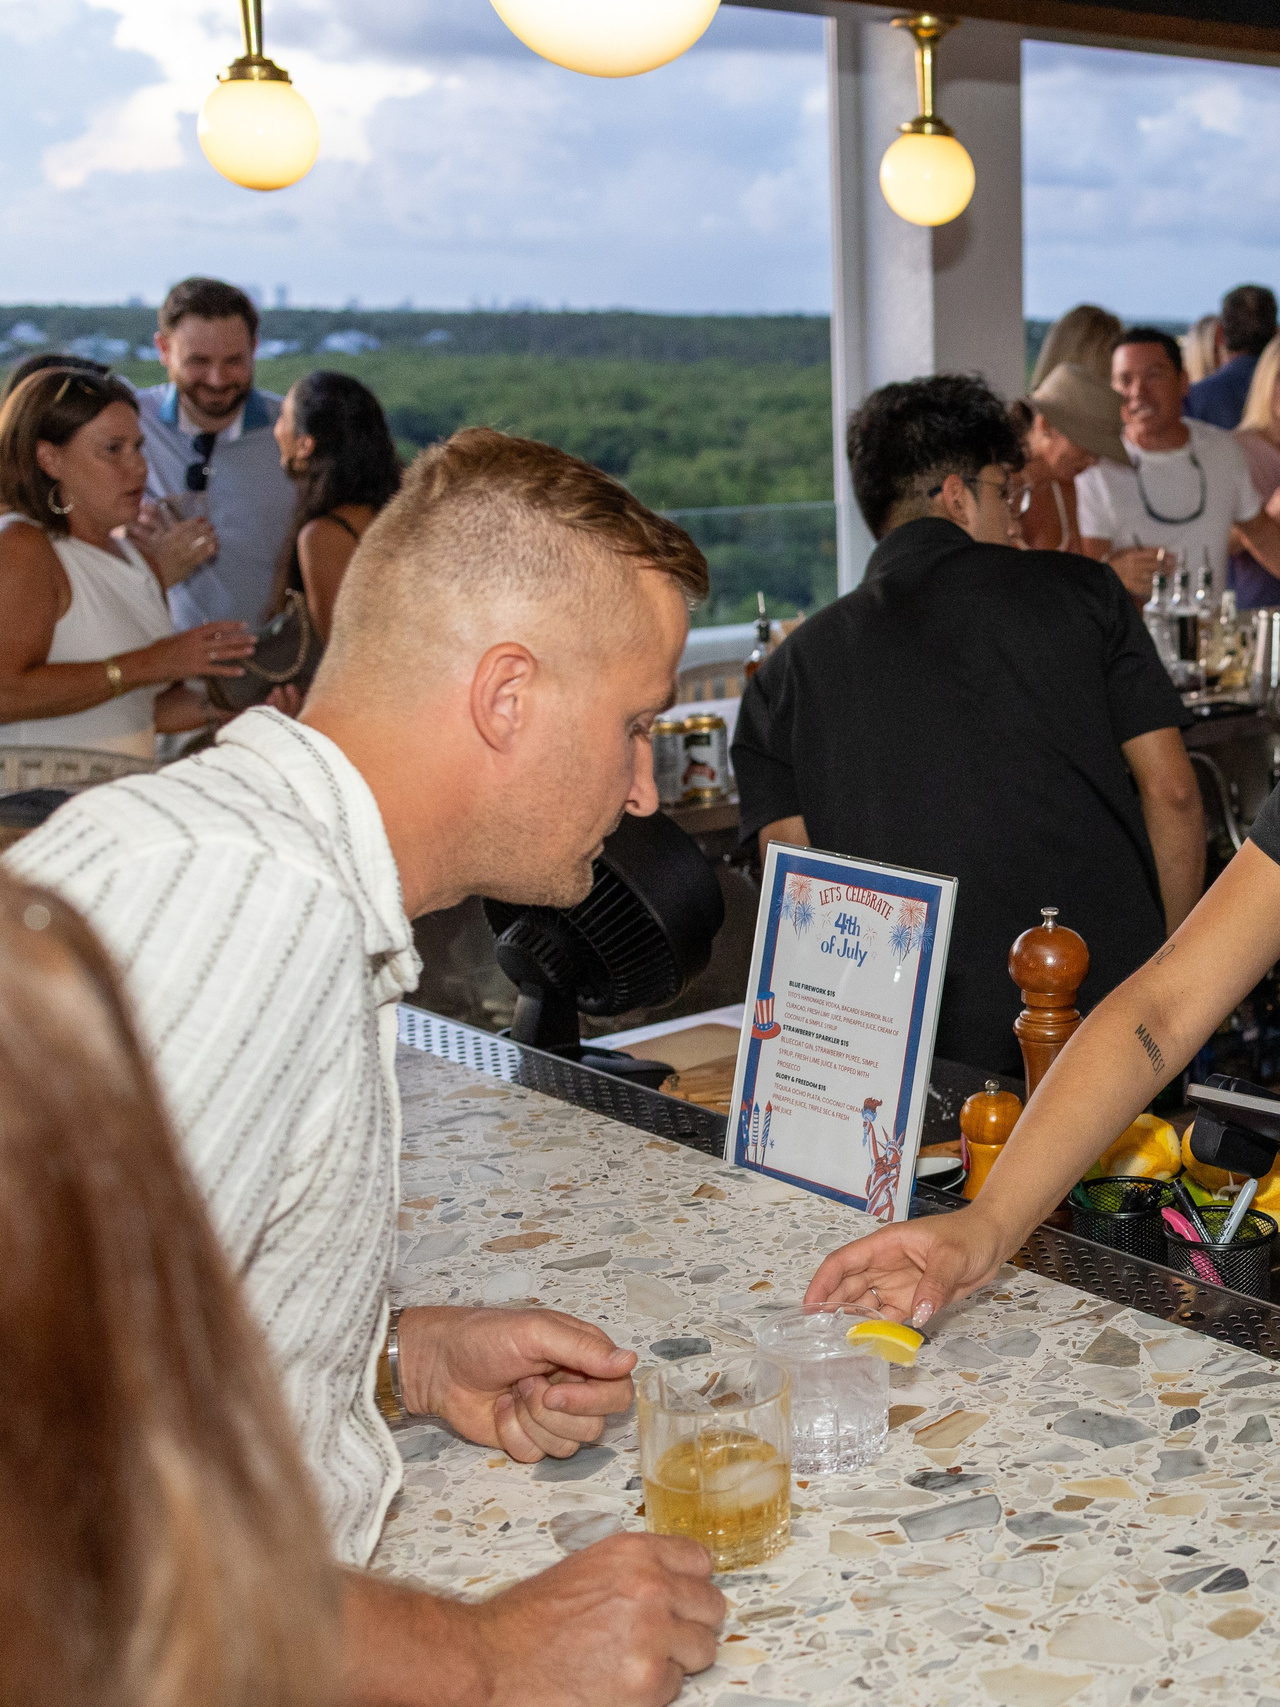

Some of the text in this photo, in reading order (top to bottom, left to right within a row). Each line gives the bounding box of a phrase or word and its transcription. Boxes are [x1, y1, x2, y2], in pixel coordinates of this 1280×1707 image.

[819, 886, 894, 920] LET'S CELEBRATE
[834, 912, 860, 936] 4th
[820, 935, 868, 968] of July
[789, 980, 801, 989] BLUE
[801, 983, 826, 995] FIREWORK
[784, 1012, 805, 1023] COCONUT
[809, 1019, 823, 1028] SIMPLE
[824, 1023, 838, 1032] SYRUP
[801, 995, 825, 1006] HANDMADE
[882, 1016, 893, 1024] BLUE
[807, 1007, 820, 1016] FRESH
[843, 1017, 865, 1028] PINEAPPLE
[877, 1026, 892, 1035] CREAM
[783, 1024, 815, 1038] STRAWBERRY
[815, 1033, 840, 1045] SPARKLER
[781, 1036, 804, 1048] BLUECOAT
[815, 1045, 844, 1059] STRAWBERRY
[862, 1058, 879, 1068] SIMPLE
[795, 1052, 809, 1062] FRESH
[809, 1056, 820, 1065] LIME
[820, 1060, 833, 1070] JUICE
[838, 1065, 857, 1075] TOPPED
[857, 1070, 870, 1078] WITH
[777, 1060, 801, 1072] PROSECCO
[775, 1072, 791, 1081] GLORY
[795, 1077, 817, 1089] FREEDOM
[772, 1093, 794, 1105] PINEAPPLE
[808, 1104, 822, 1113] TRIPLE
[823, 1108, 831, 1116] SEC
[836, 1112, 850, 1122] FRESH
[774, 1083, 791, 1093] TEQUILA
[792, 1088, 806, 1098] OCHO
[822, 1097, 846, 1109] COCONUT
[846, 1104, 863, 1114] CREAM
[780, 1107, 792, 1117] JUICE
